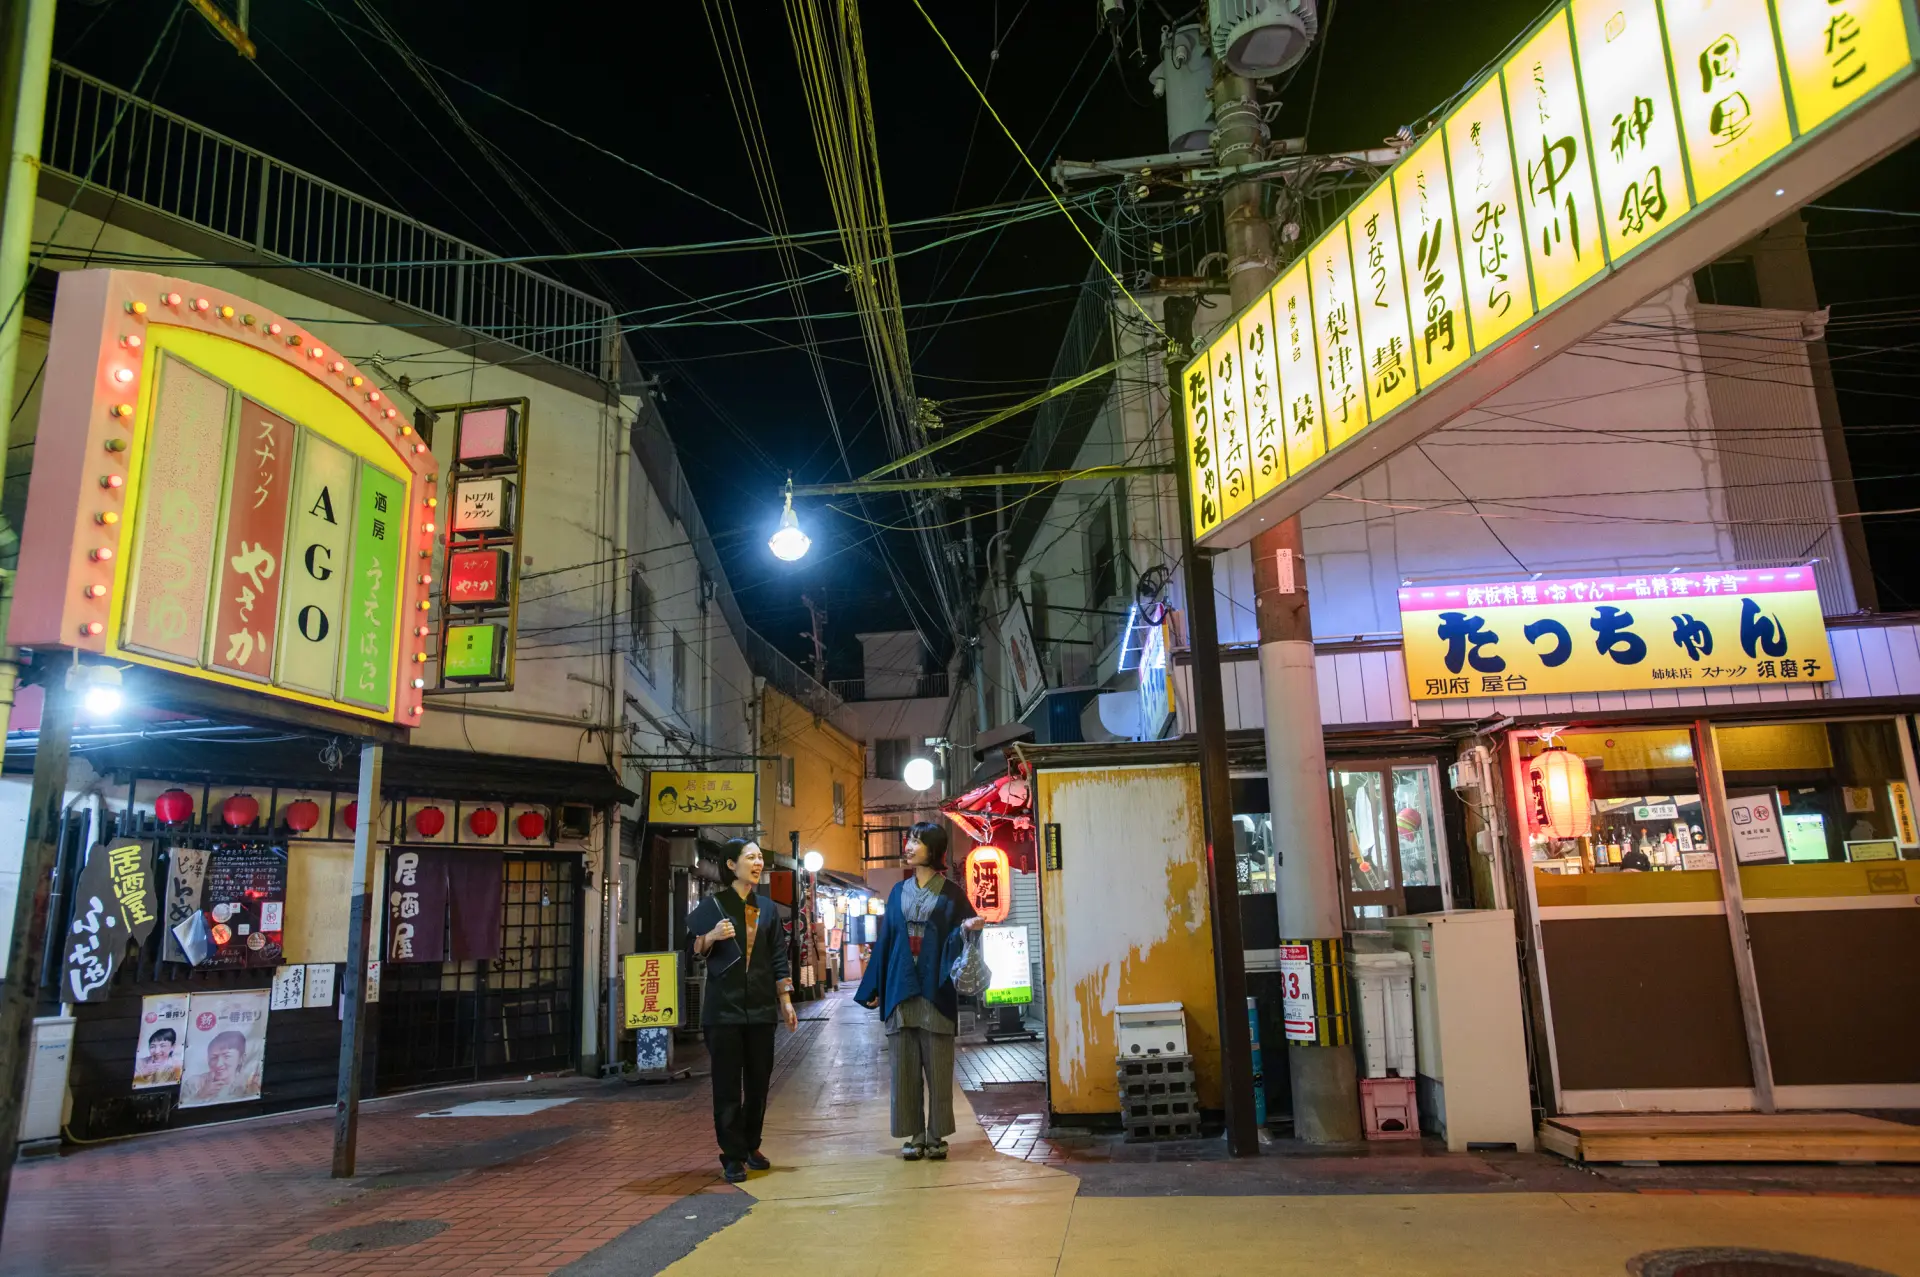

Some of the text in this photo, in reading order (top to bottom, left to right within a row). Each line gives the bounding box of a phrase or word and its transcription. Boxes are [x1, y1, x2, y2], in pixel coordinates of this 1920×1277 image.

[1527, 133, 1582, 262] 中川
[1471, 201, 1511, 318] みはら
[1325, 301, 1357, 424] 梨津子
[1371, 336, 1407, 398] 慧
[253, 420, 276, 509] スナック
[371, 491, 388, 541] 酒房
[464, 509, 495, 519] クラウン
[297, 485, 339, 643] AGO
[455, 579, 494, 594] やさか
[225, 540, 277, 666] やさか
[1425, 674, 1528, 696] 別府 屋台
[1651, 658, 1821, 680] 姉妹店 スナック 須磨子
[683, 780, 735, 792] 居酒屋
[108, 844, 154, 934] 居酒屋
[165, 876, 194, 930] らーめ
[390, 852, 420, 960] 居酒屋
[640, 959, 661, 1014] 居酒屋
[158, 1010, 186, 1020] 一番搾り
[201, 1013, 213, 1026] 新
[217, 1010, 262, 1023] 一番搾り
